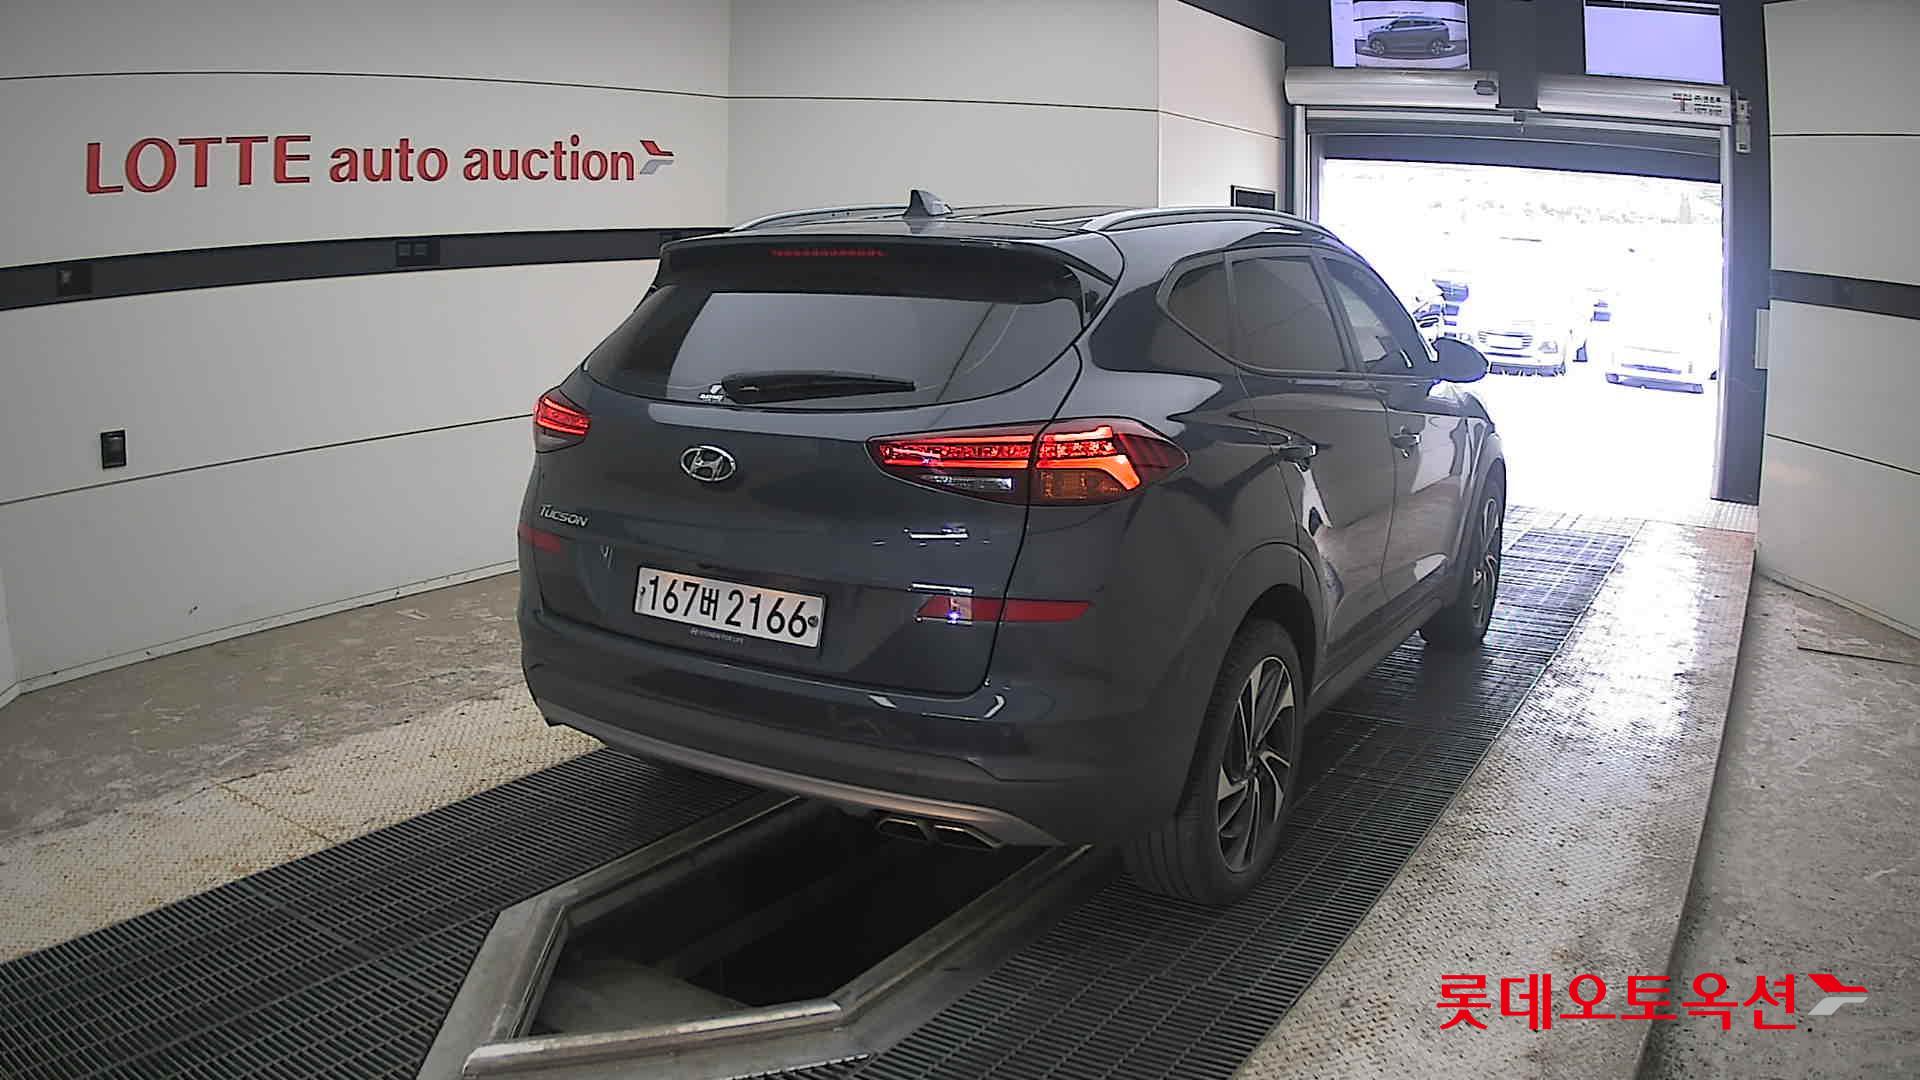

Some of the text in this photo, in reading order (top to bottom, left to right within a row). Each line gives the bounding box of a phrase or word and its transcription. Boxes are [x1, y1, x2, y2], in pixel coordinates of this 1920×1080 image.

[86, 134, 636, 195] LOTTE auto auction
[540, 504, 588, 526] TUCSON
[649, 575, 808, 639] 167버 2166
